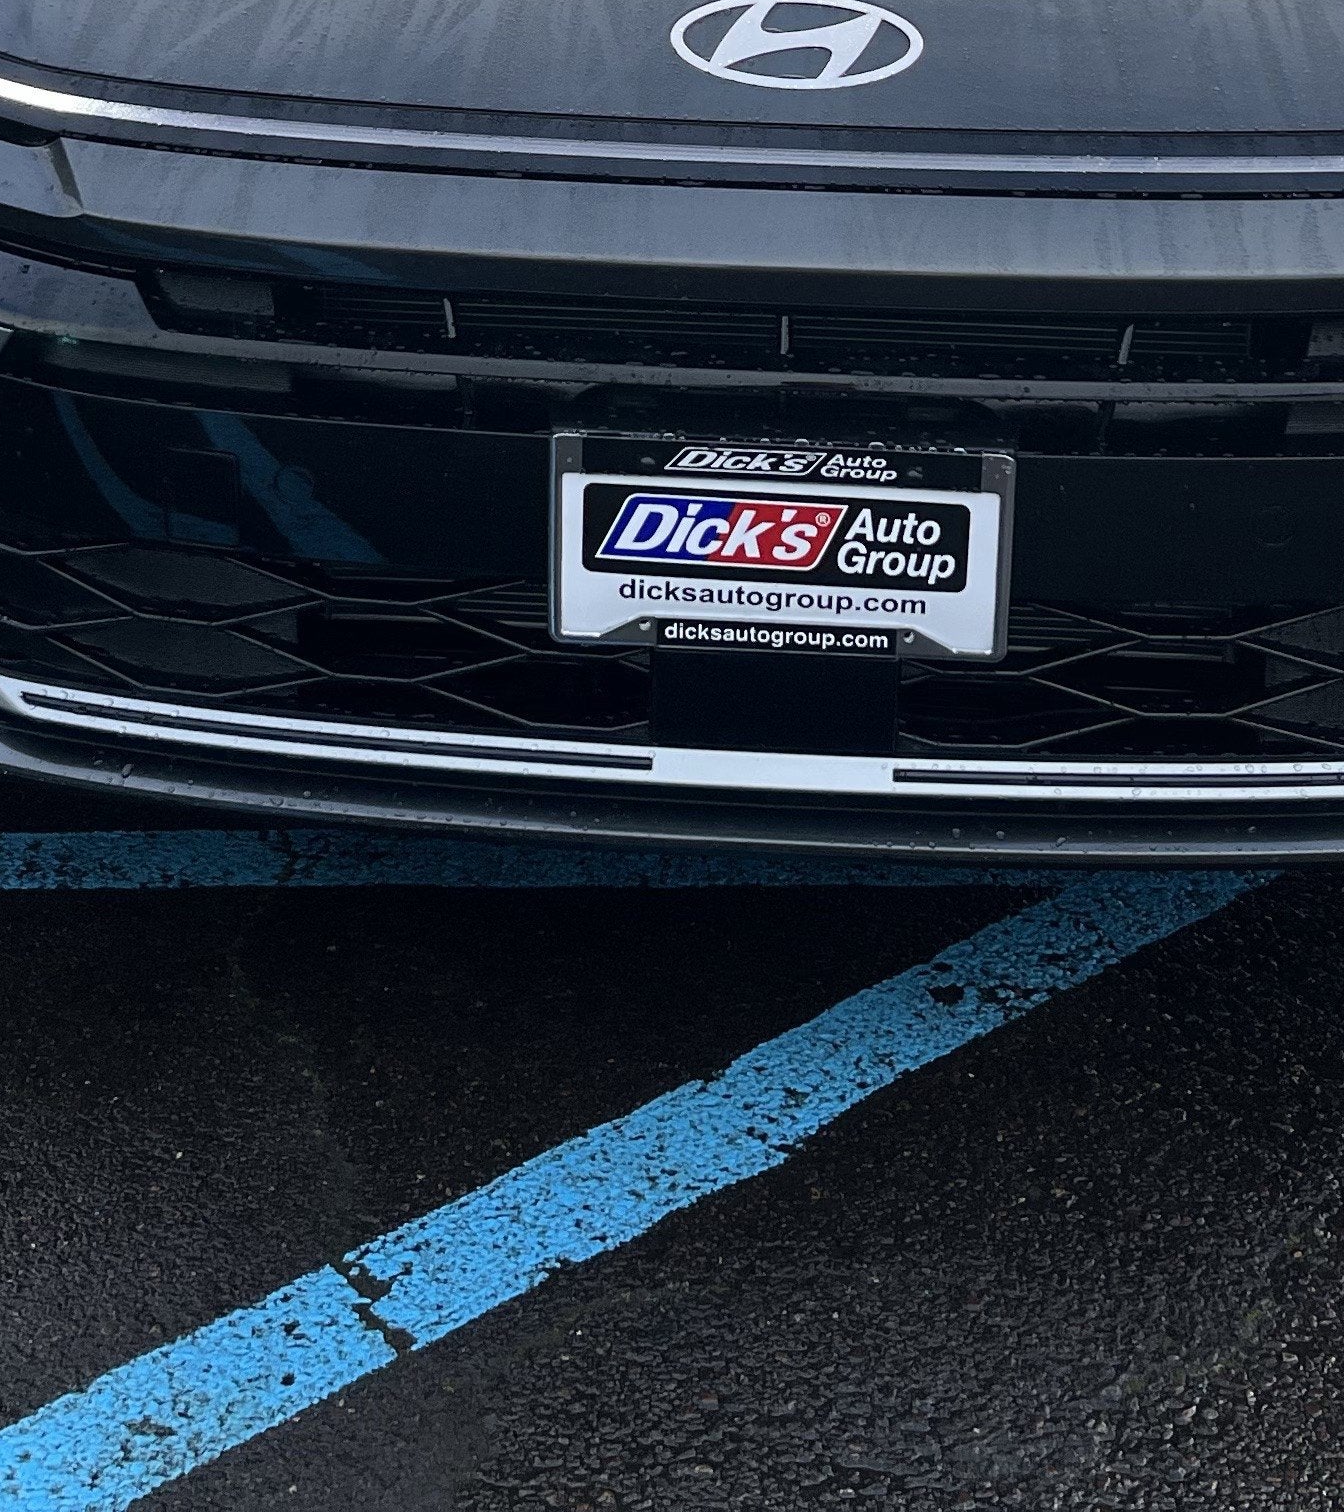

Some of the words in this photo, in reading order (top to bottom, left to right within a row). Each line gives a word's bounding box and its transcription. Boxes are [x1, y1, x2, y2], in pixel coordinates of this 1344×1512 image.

[677, 449, 808, 472] Dick's
[827, 453, 887, 468] Auto
[820, 466, 898, 482] Group
[613, 502, 820, 560] Dick's
[845, 508, 941, 545] Auto
[837, 541, 956, 585] Group
[619, 578, 927, 615] dicksautogroup.com
[664, 622, 889, 649] dicksautogroup.com
